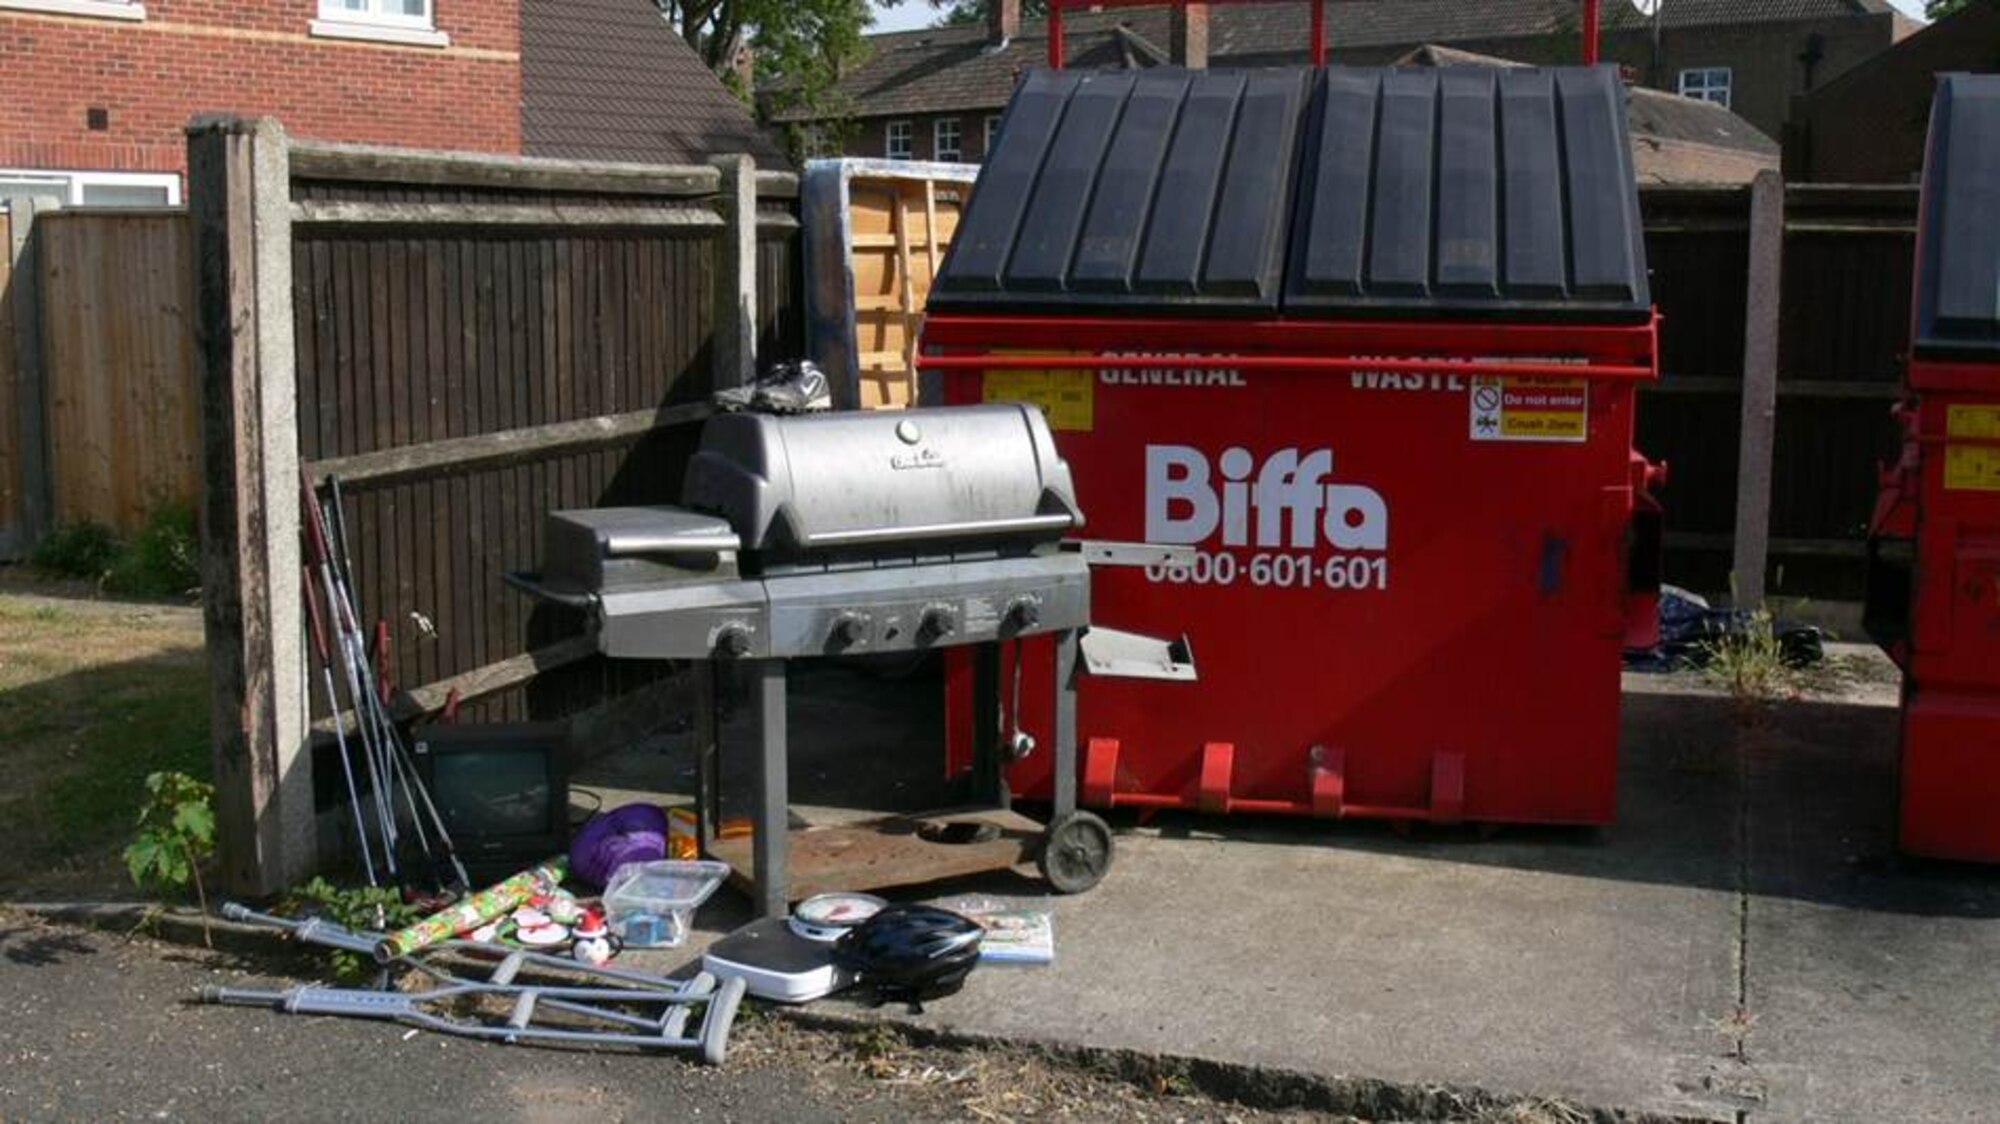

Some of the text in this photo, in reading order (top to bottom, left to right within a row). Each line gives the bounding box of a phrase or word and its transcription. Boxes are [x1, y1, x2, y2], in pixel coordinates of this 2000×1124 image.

[1100, 352, 1464, 390] GENERAL WASTE
[1504, 393, 1583, 405] Do not enter
[1507, 418, 1577, 430] Crush Zone
[1145, 444, 1388, 551] Biffa
